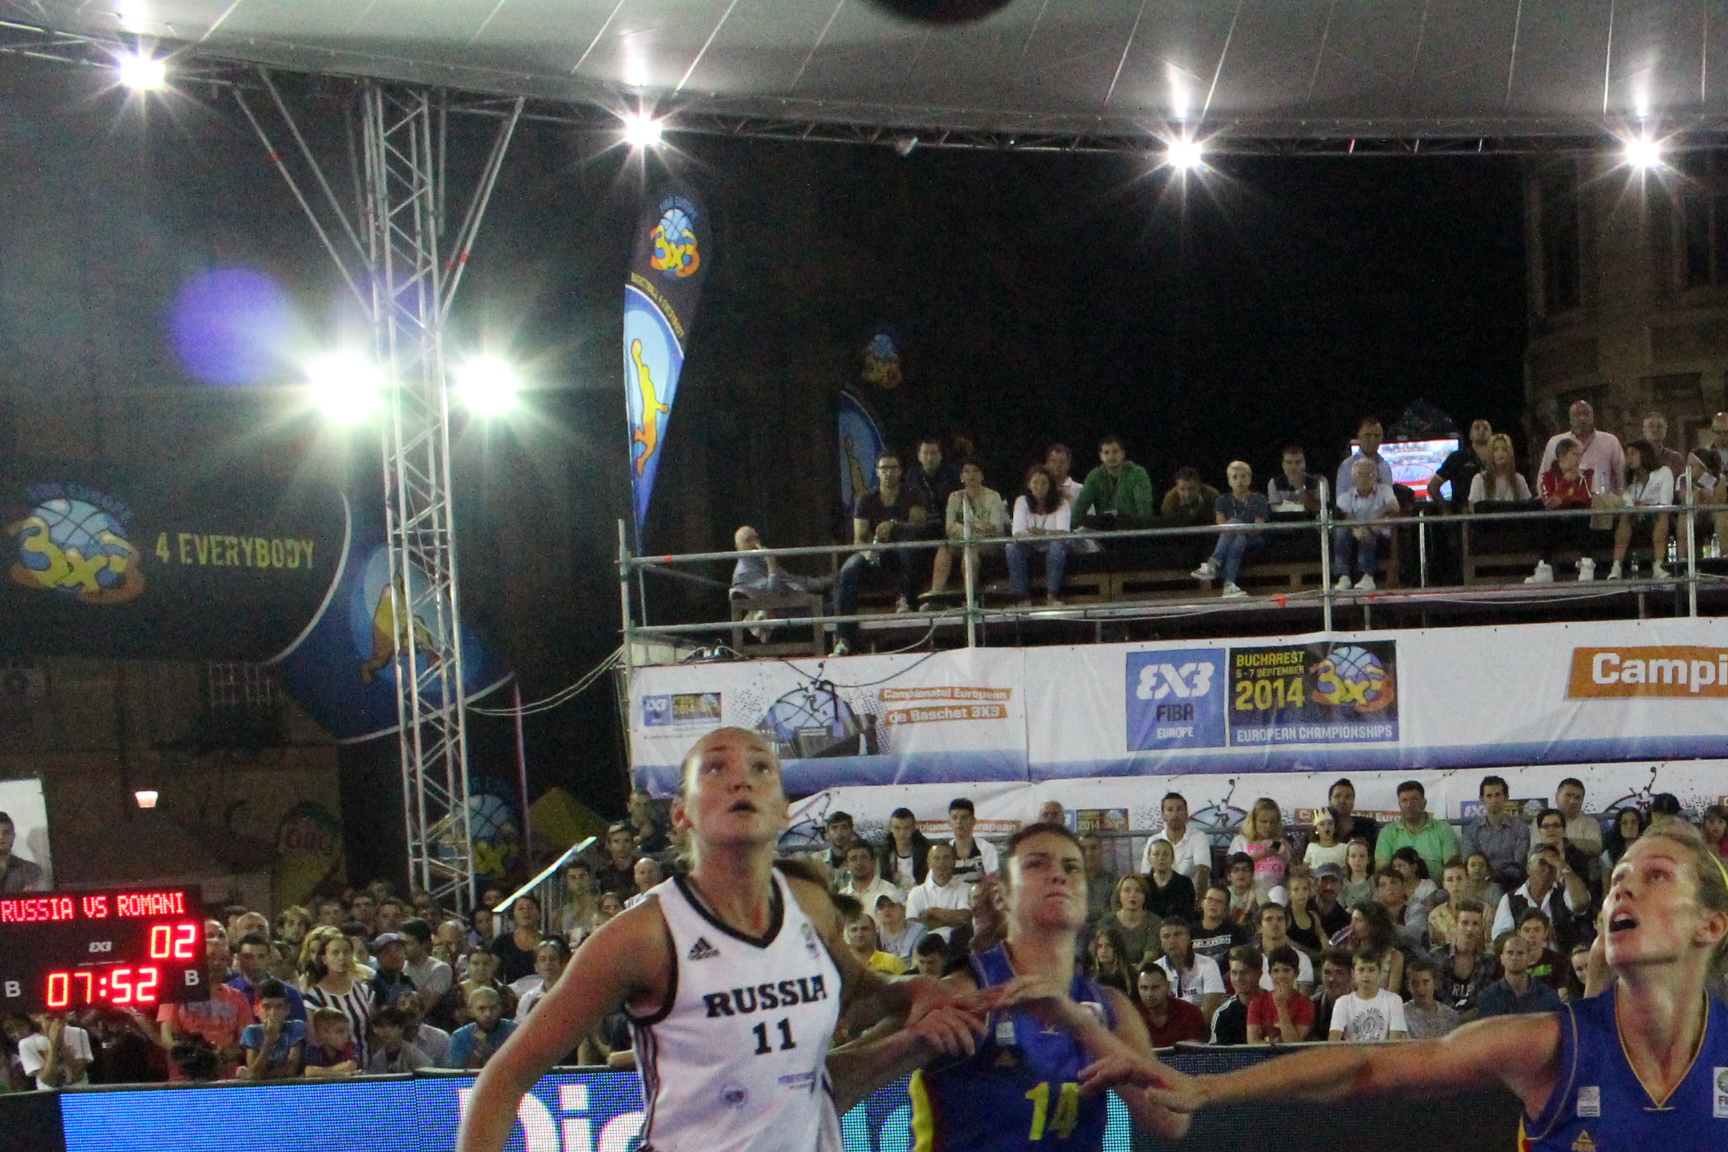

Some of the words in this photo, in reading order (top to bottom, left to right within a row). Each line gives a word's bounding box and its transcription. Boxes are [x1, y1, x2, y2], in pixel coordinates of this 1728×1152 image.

[155, 532, 170, 563] 4
[178, 533, 315, 569] EVERYBODY
[1236, 651, 1305, 667] BUCHAREST
[1236, 669, 1242, 677] 5
[1257, 665, 1304, 677] SEPTEMBER
[884, 688, 950, 700] Campionatul
[954, 688, 1007, 700] European
[1236, 678, 1305, 711] 2014
[889, 713, 907, 724] de
[910, 707, 968, 721] Baschet
[971, 706, 1000, 718] 3X3
[1156, 703, 1194, 722] FIBA
[1157, 726, 1194, 739] EUROPE
[1237, 727, 1295, 742] EUROPEAN
[1299, 725, 1392, 740] CHAMPIONSHIPS
[1, 899, 75, 922] RUSSIA
[83, 896, 108, 918] VS
[117, 892, 185, 917] ROMANI
[150, 924, 197, 959] 02
[47, 967, 158, 1007] 07:52
[184, 969, 200, 987] B
[5, 980, 21, 998] B
[703, 974, 828, 1018] RUSSIA
[753, 1017, 796, 1056] 11
[1025, 1081, 1080, 1140] 14
